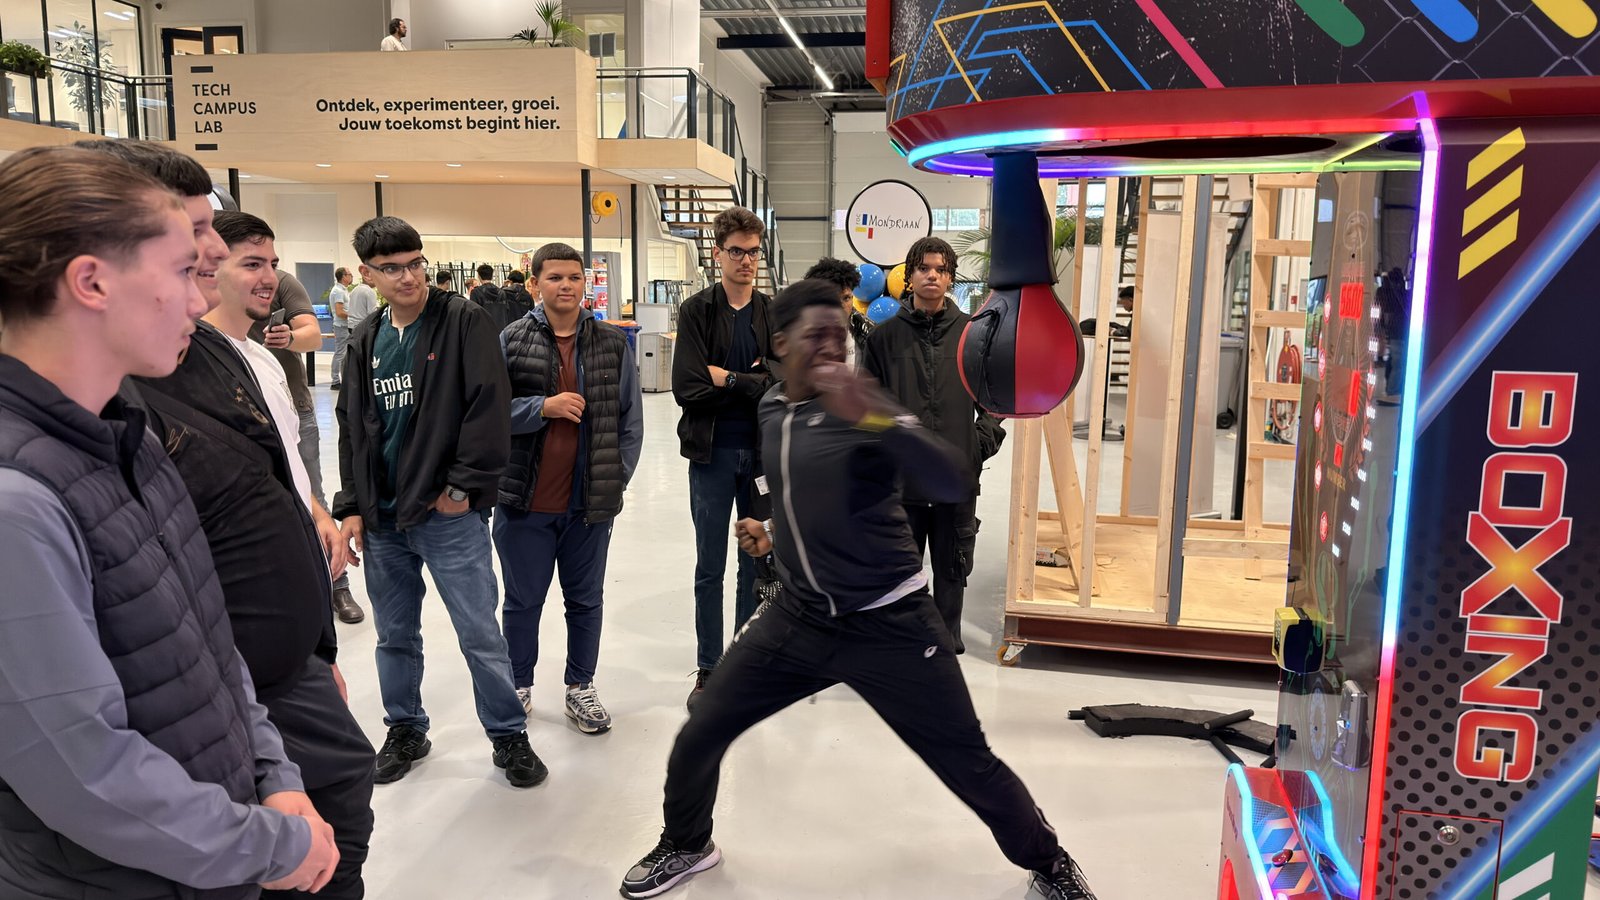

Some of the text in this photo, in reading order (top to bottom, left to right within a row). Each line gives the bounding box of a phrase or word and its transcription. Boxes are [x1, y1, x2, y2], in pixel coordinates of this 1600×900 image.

[191, 83, 231, 97] TECH
[193, 101, 257, 115] CAMPUS
[315, 95, 560, 115] Ontdek, experimenteer, groei.
[194, 120, 223, 134] LAB
[338, 115, 561, 134] Jouw toekomst begint hier.
[1453, 370, 1579, 783] BOXING
